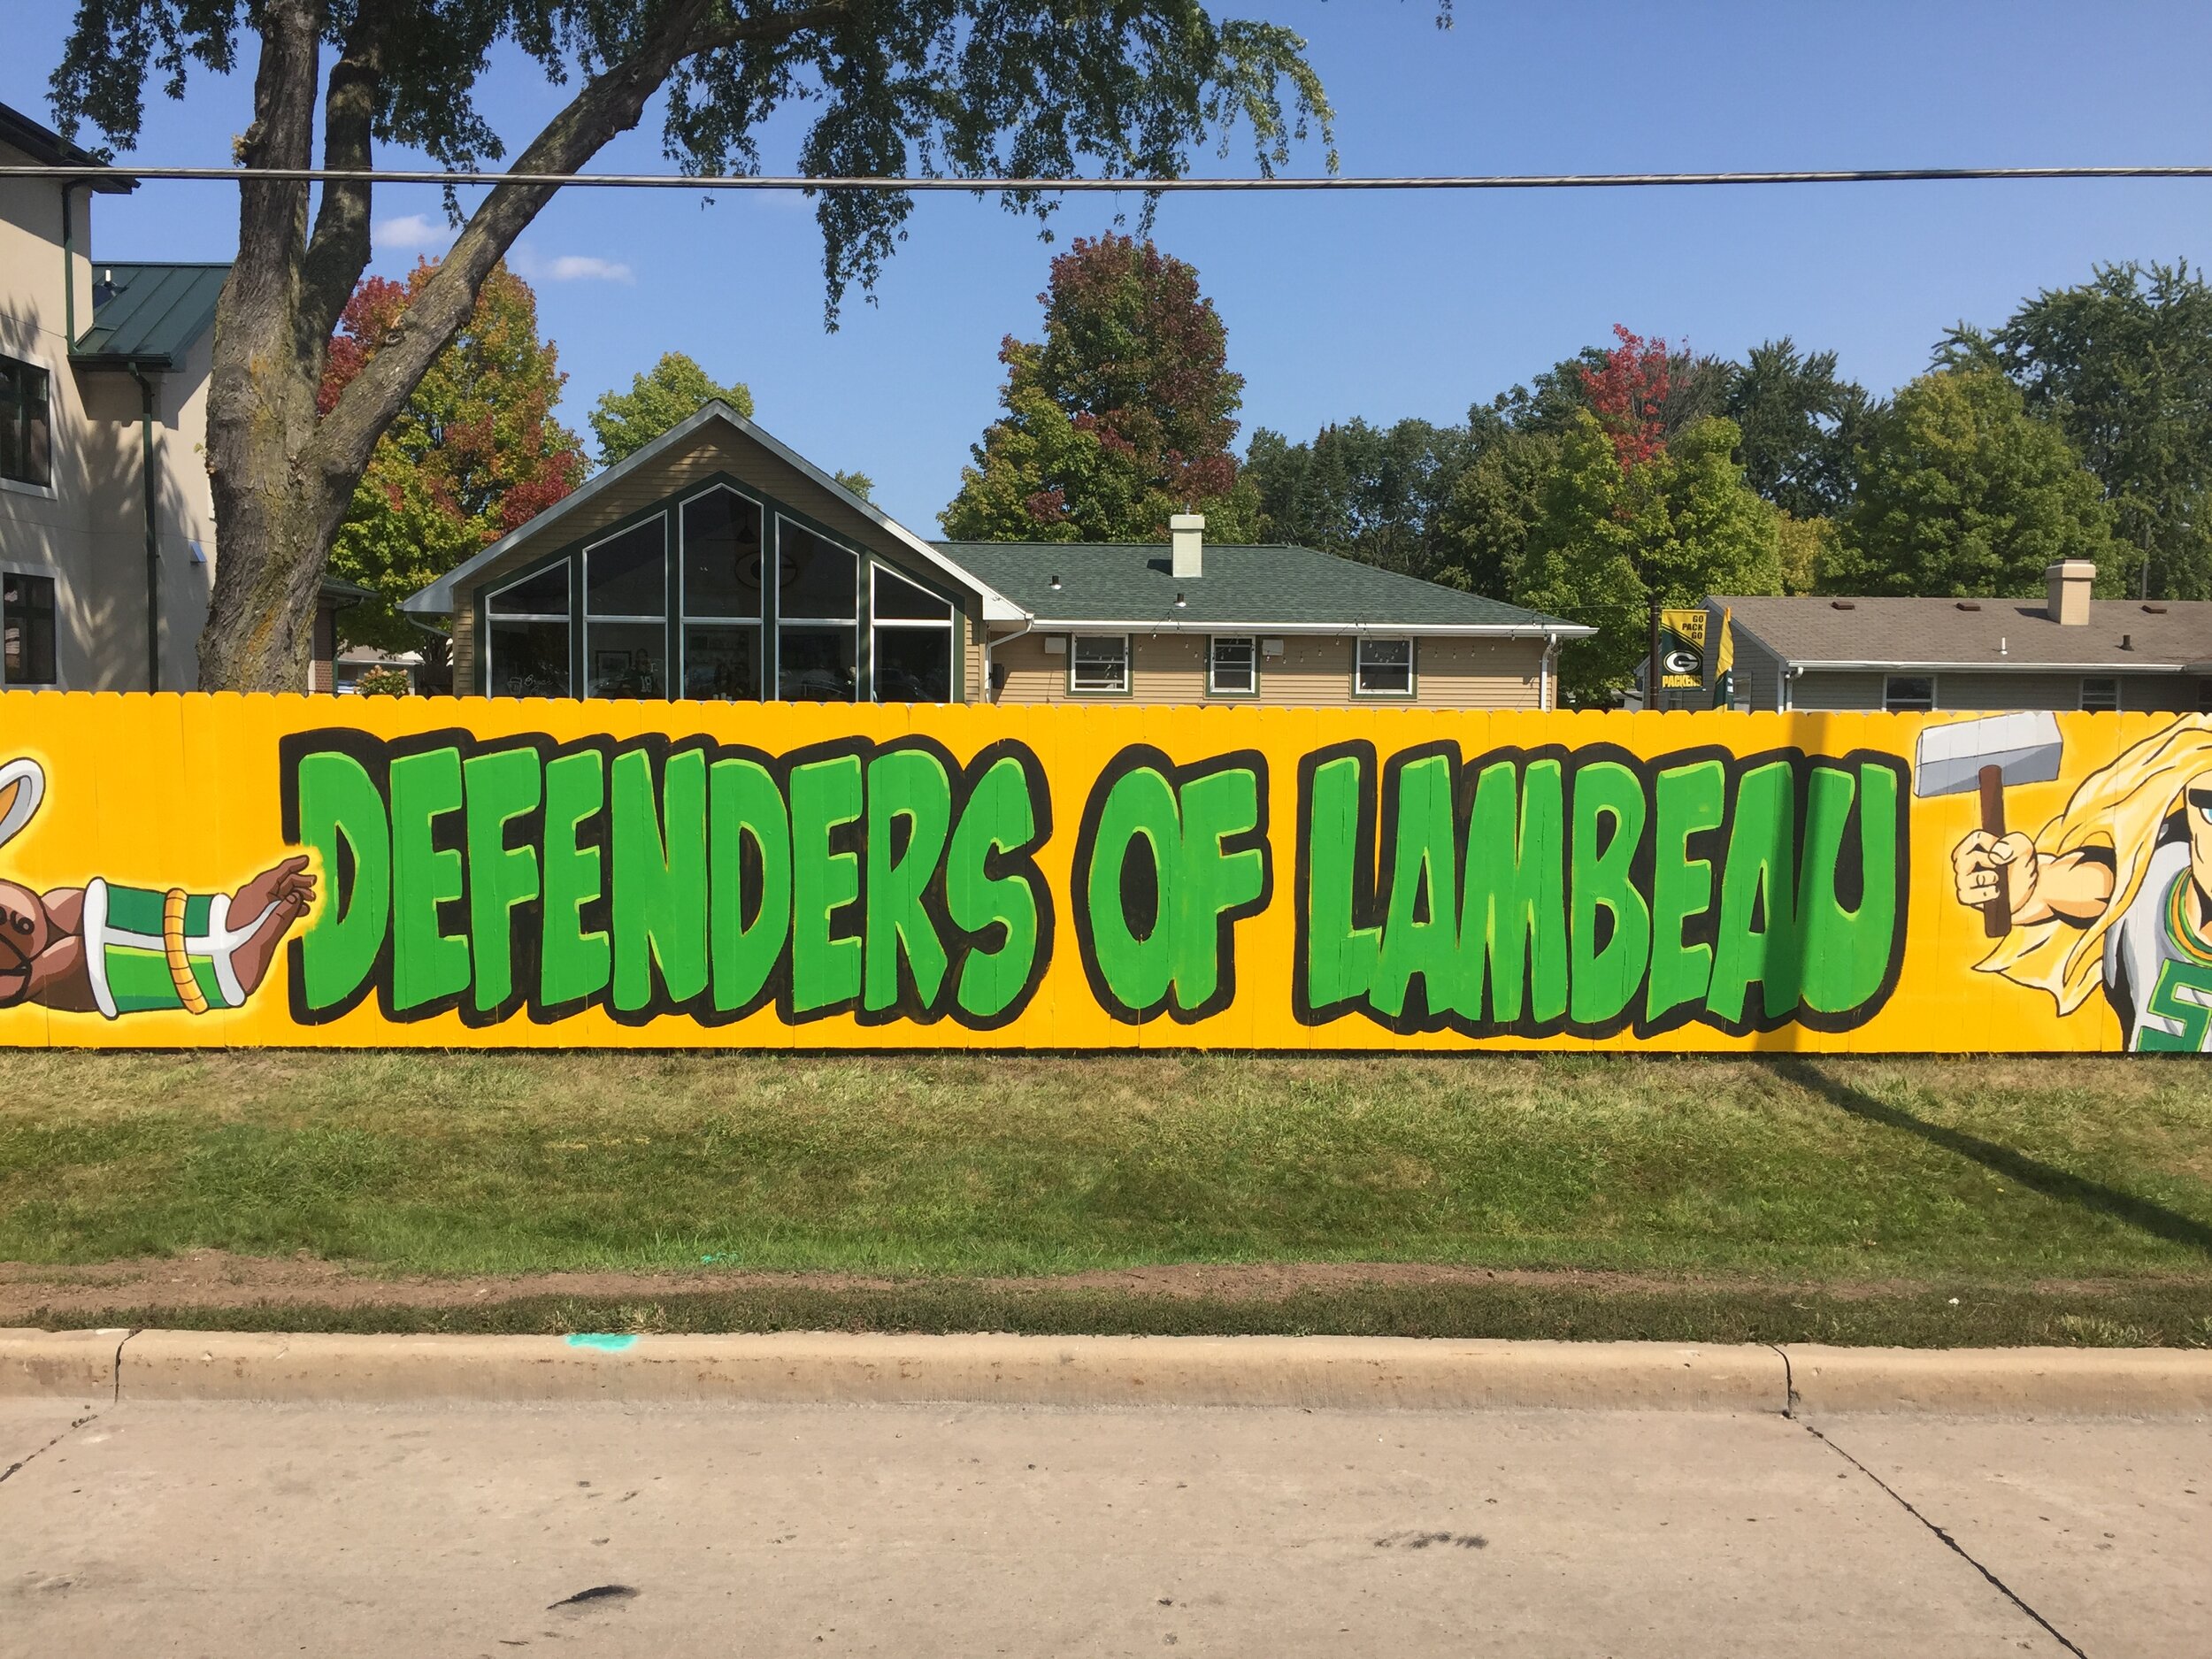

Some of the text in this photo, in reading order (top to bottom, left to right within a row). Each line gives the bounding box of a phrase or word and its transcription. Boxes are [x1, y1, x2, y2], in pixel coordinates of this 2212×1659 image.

[1665, 651, 1700, 673] G
[1662, 674, 1702, 688] PACKERS
[281, 729, 1909, 1038] DEFENDERS OF LAMBEAU
